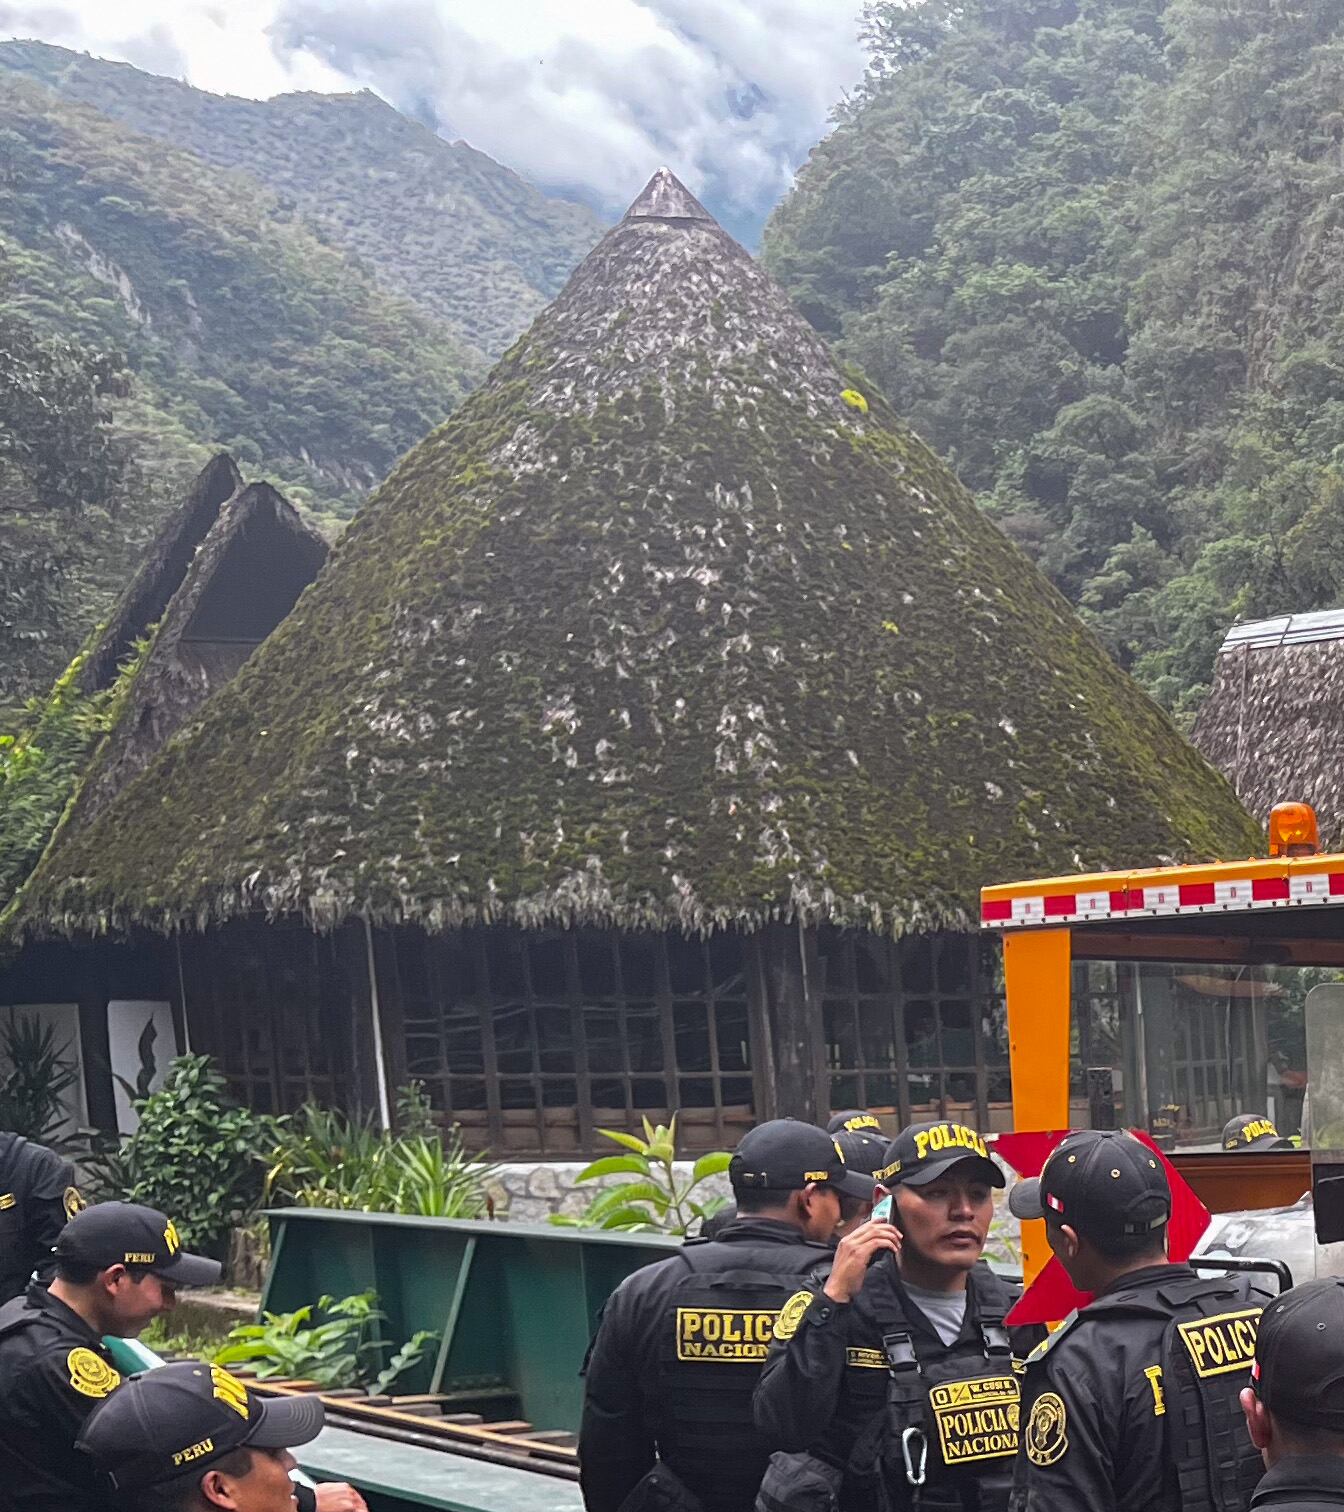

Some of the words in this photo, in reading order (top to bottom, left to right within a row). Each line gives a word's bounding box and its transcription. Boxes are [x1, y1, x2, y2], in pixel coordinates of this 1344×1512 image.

[124, 1253, 155, 1263] PERU
[683, 1313, 779, 1342] POLIC
[683, 1342, 768, 1357] NACION
[942, 1407, 1009, 1439] POLICIA
[171, 1438, 214, 1466] PERU
[947, 1432, 1018, 1457] NACIONA
